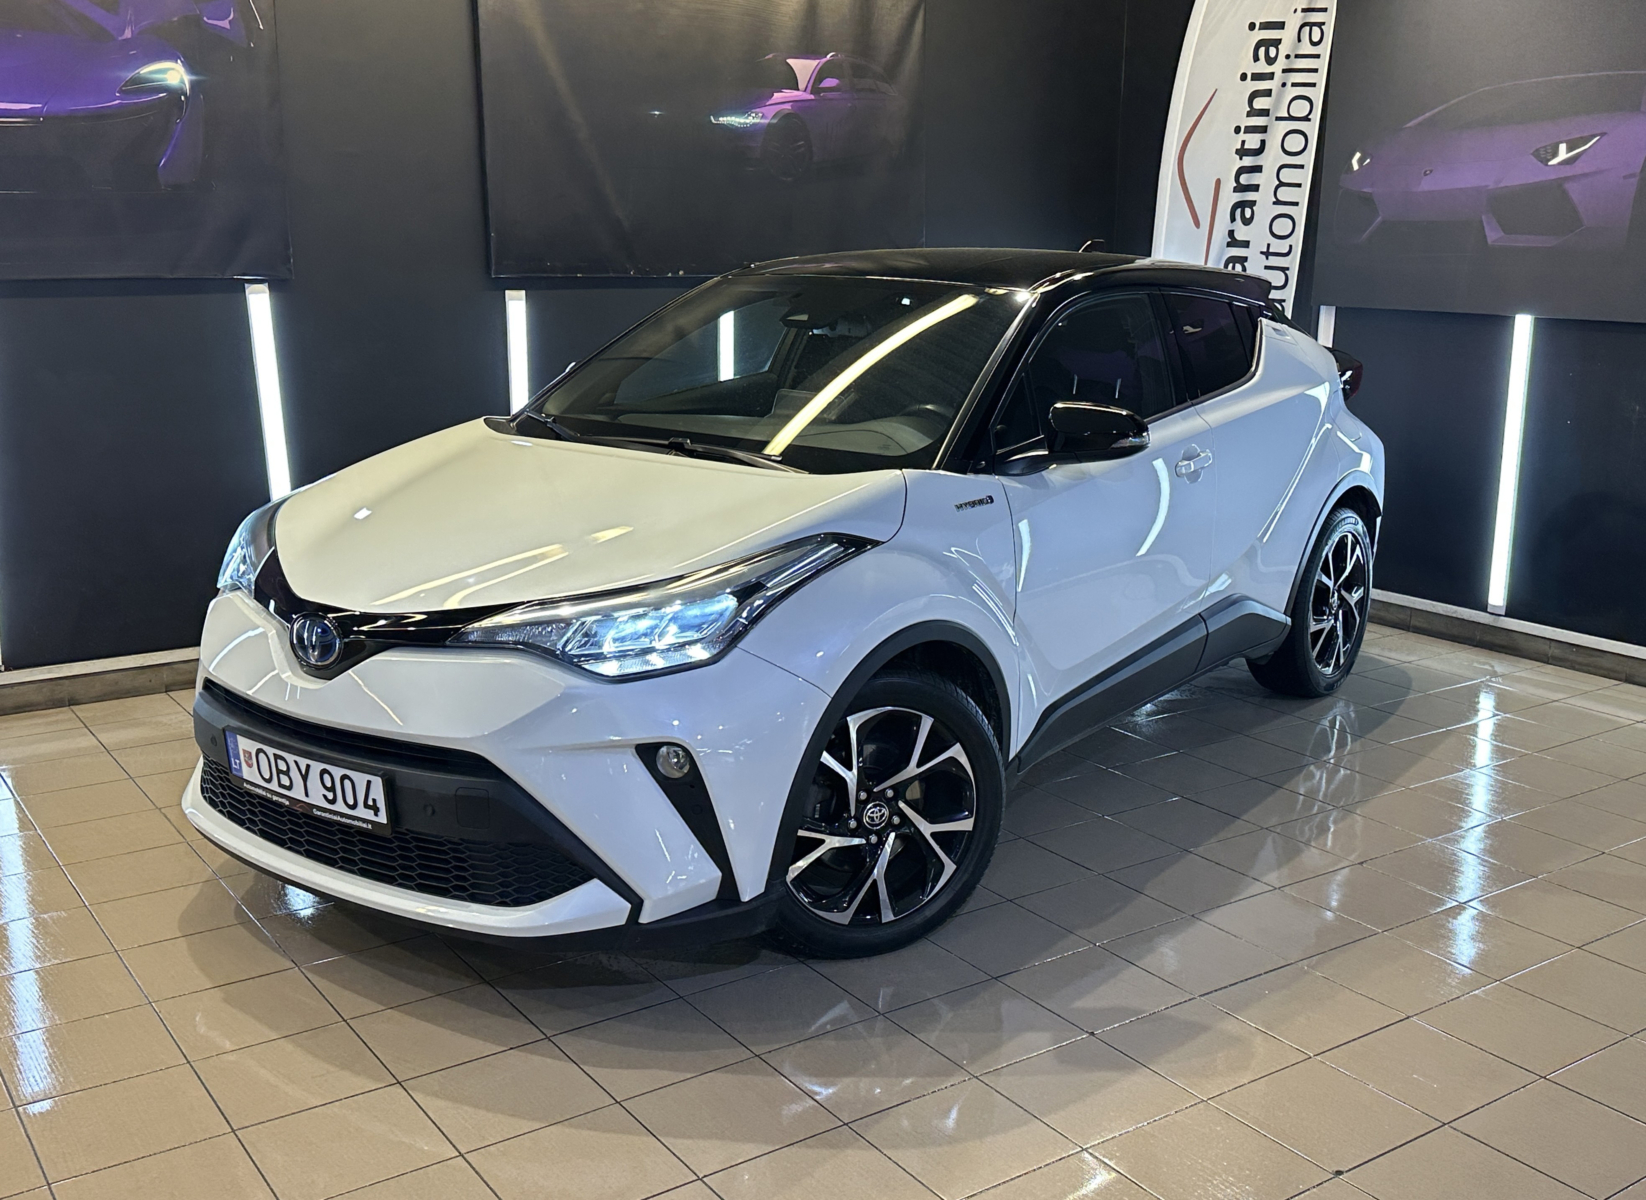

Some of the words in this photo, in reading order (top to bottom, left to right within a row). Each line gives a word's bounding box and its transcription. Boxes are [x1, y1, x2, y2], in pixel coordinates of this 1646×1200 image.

[231, 757, 240, 770] LT
[255, 747, 311, 798] OBY
[319, 767, 380, 818] 904
